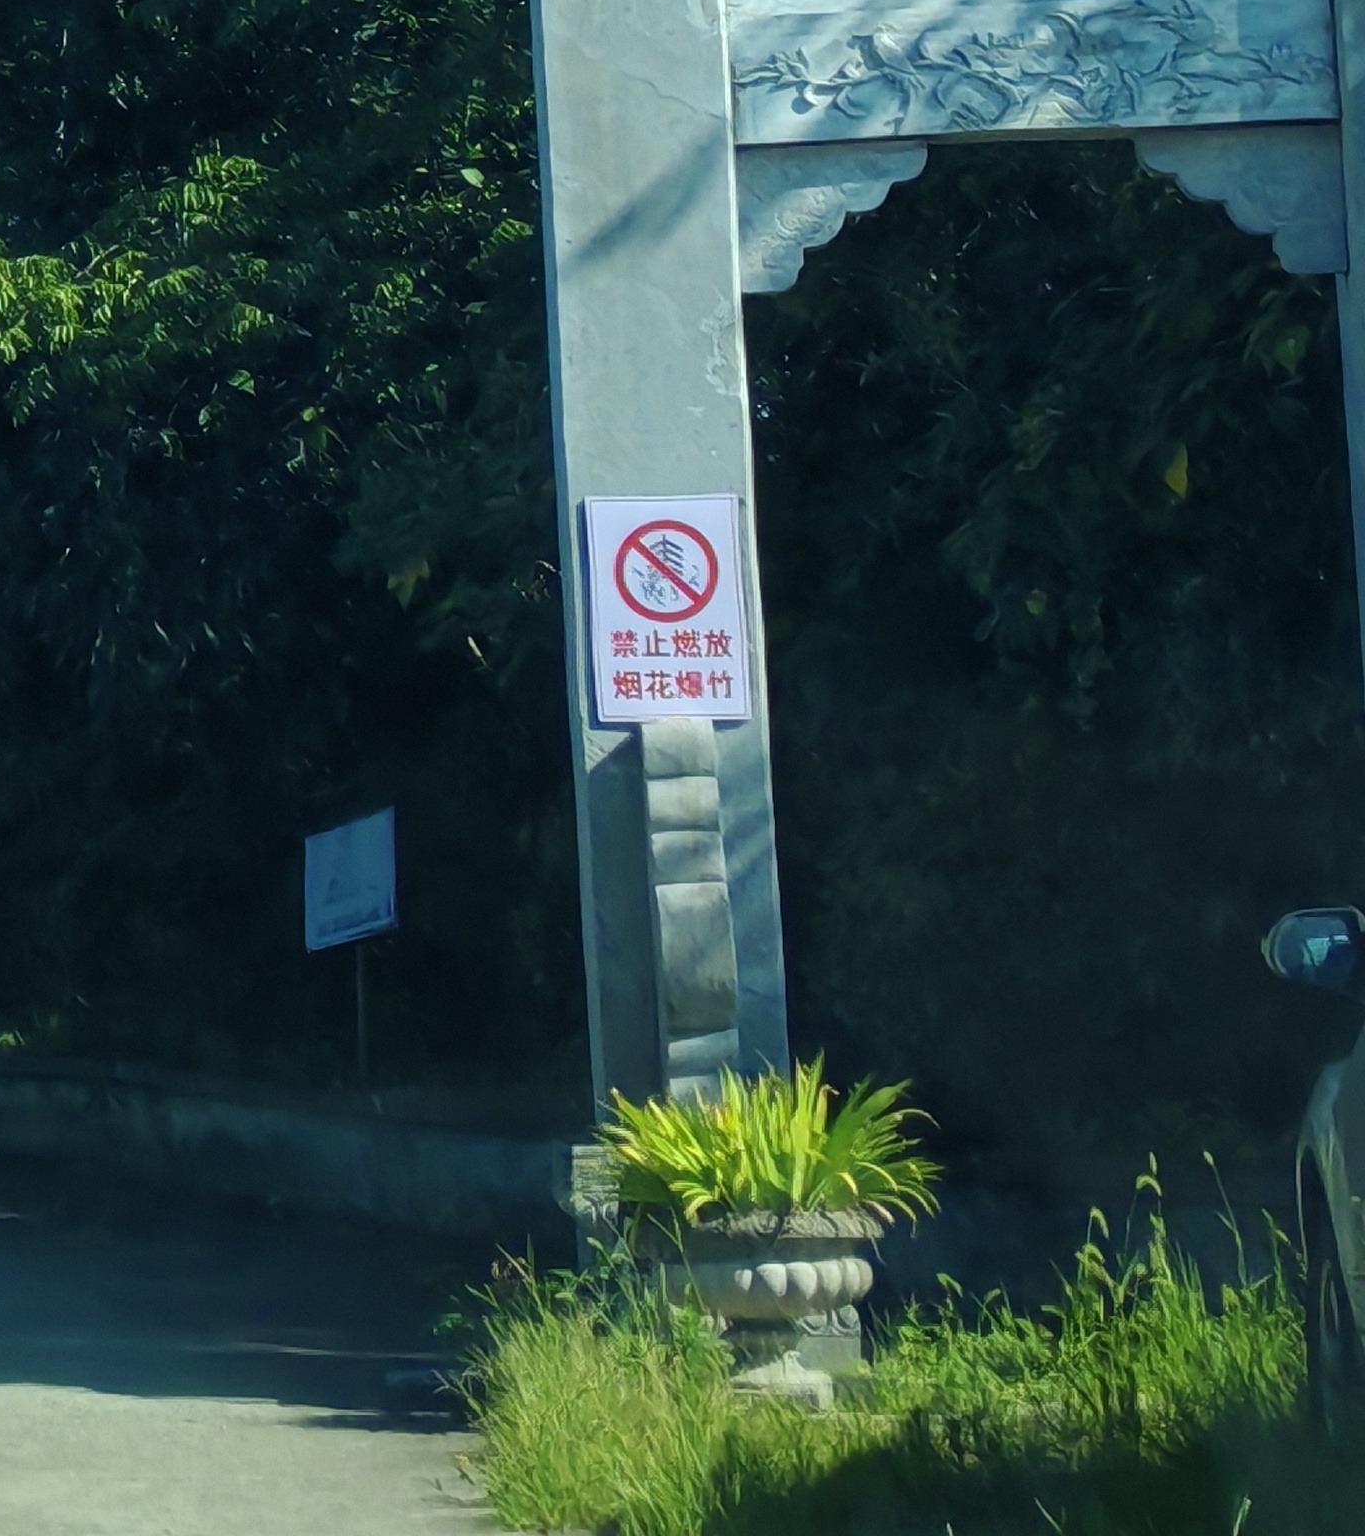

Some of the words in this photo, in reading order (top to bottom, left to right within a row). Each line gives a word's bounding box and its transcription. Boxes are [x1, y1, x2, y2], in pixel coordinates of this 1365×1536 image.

[611, 629, 732, 658] 禁止燃放
[613, 670, 733, 700] 烟花爆竹
